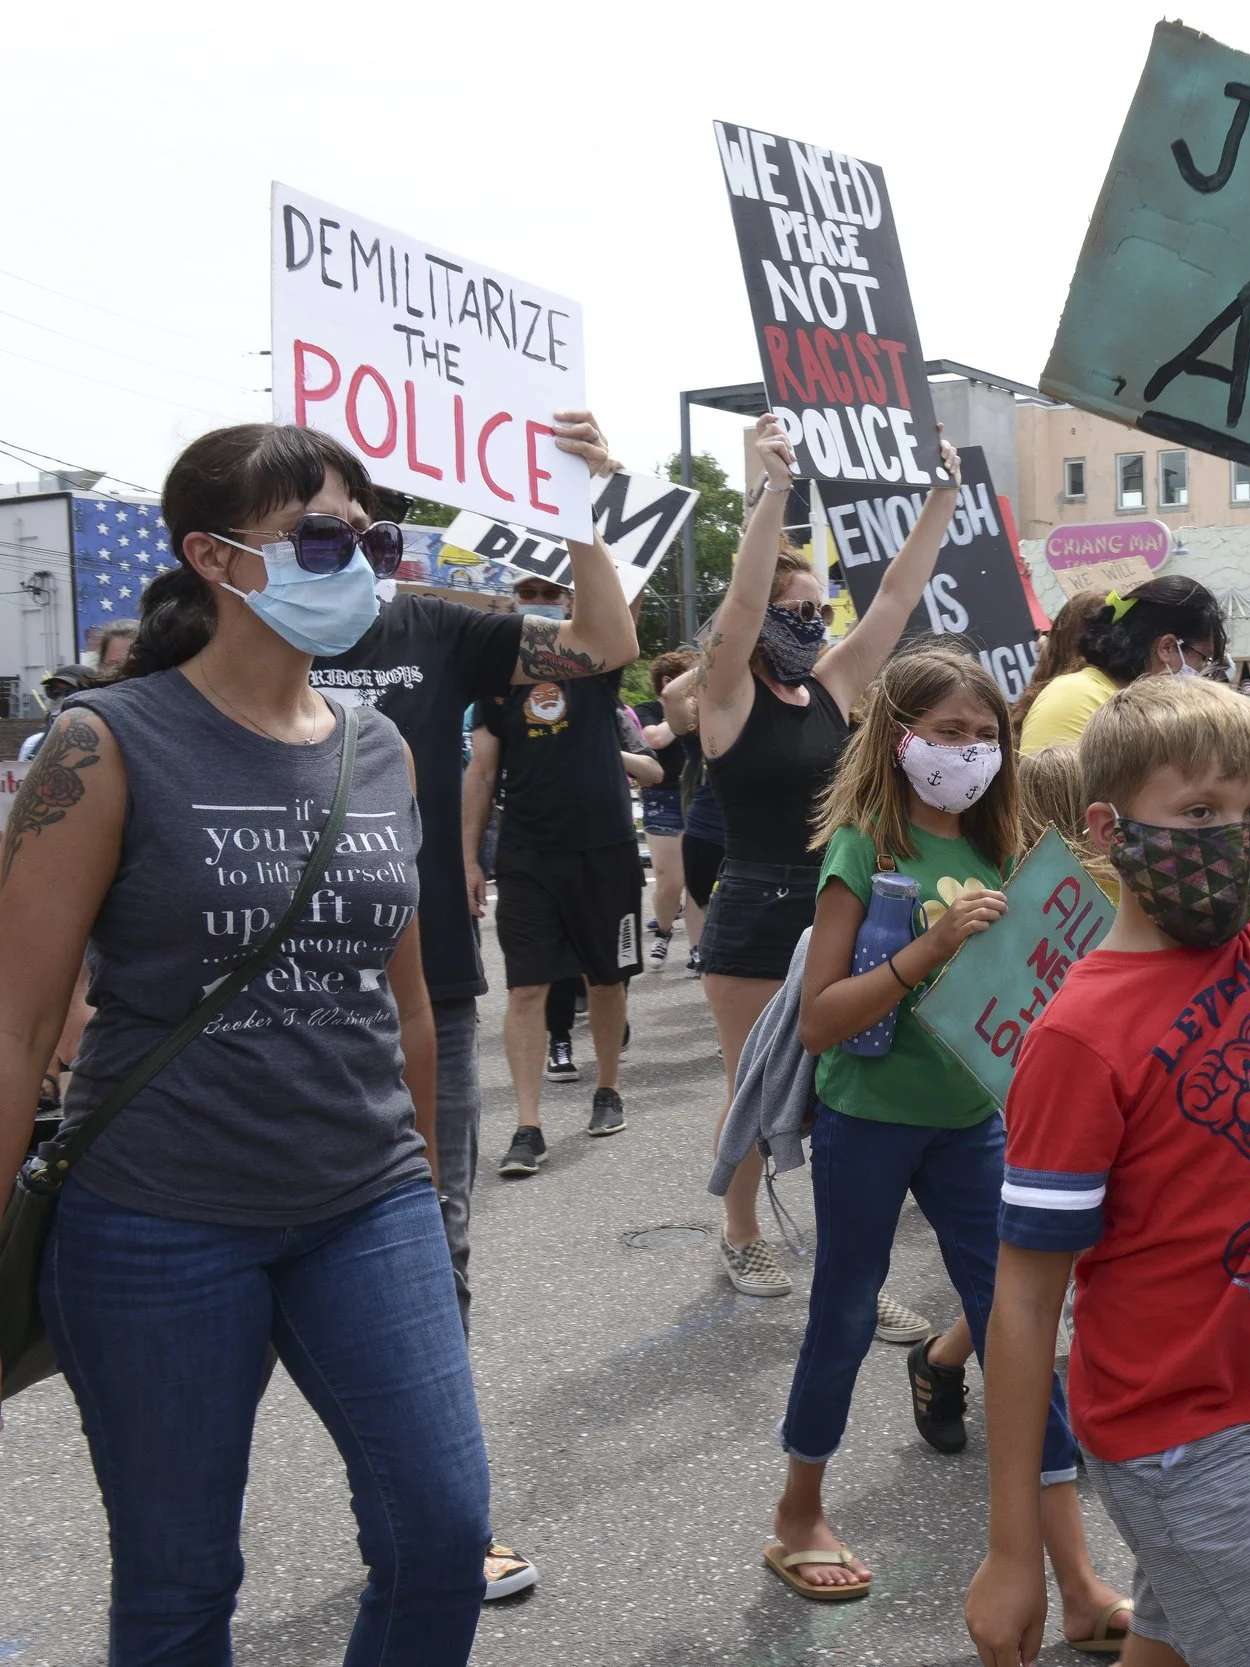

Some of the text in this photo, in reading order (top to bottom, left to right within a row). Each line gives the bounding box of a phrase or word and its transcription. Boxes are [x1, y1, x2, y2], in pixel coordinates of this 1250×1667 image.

[714, 120, 882, 230] WE NEED
[769, 206, 870, 271] PEACE
[283, 204, 570, 371] DEMILITARIZE
[761, 259, 880, 335] NOT
[393, 324, 465, 386] THE
[763, 325, 912, 409] RACIST
[293, 339, 561, 515] POLICE
[1048, 533, 1163, 557] CHIANG MAI
[922, 573, 970, 635] IS
[1068, 564, 1137, 590] WE WILL
[373, 665, 424, 689] BOYS
[295, 799, 314, 821] if
[202, 827, 289, 866] you
[217, 861, 407, 886] to lift urself
[371, 902, 416, 939] up
[265, 956, 345, 994] else
[1026, 937, 1073, 995] NE
[202, 1007, 392, 1035] Booker T. Washington
[974, 996, 1024, 1068] LO
